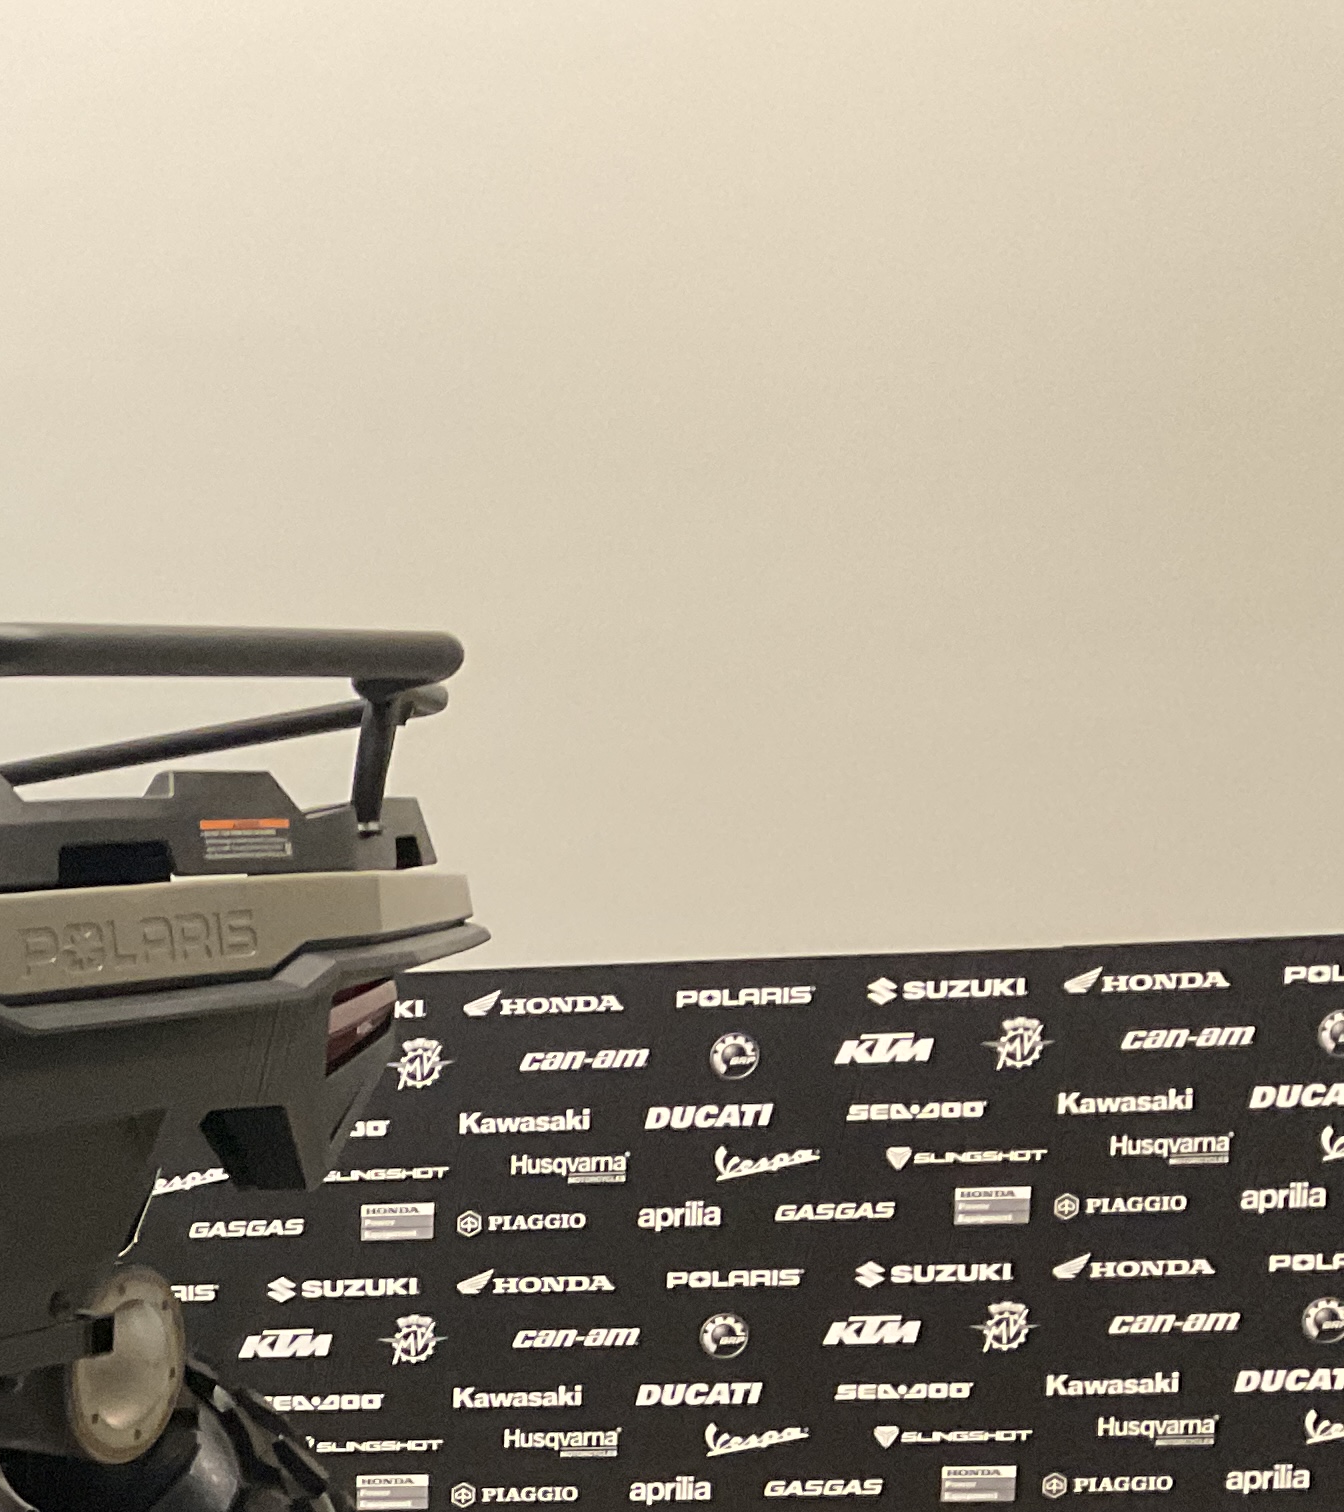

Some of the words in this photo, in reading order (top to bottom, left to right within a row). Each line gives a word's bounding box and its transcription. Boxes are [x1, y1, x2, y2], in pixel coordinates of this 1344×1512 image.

[20, 909, 258, 978] POLARIS
[902, 977, 1028, 1000] SUZUKI
[1100, 971, 1231, 993] HONDA
[500, 994, 625, 1016] HONDA
[675, 985, 817, 1009] POLARIS
[833, 1032, 935, 1065] KTM
[1120, 1025, 1256, 1050] can-am
[519, 1048, 650, 1072] can-am
[1057, 1087, 1194, 1115] Kawasaki
[1248, 1082, 1344, 1109] DUCA
[458, 1107, 591, 1135] Kawasaki
[644, 1103, 774, 1130] DUCATI
[913, 1149, 1048, 1164] SLINGSHOT
[1109, 1131, 1235, 1158] Husqvarna
[323, 1166, 450, 1184] SLINGSHOT
[510, 1151, 631, 1177] Husqvarna
[714, 1145, 821, 1182] Vespa
[151, 1167, 230, 1197] espa
[1085, 1195, 1188, 1214] PIAGGIO
[1240, 1181, 1327, 1214] aprilia
[487, 1212, 587, 1231] PIAGGIO
[637, 1200, 722, 1232] aprilia
[774, 1201, 896, 1222] GASGAS
[188, 1218, 305, 1239] GASGAS
[666, 1268, 805, 1289] POLARIS
[890, 1262, 1014, 1284] SUZUKI
[1089, 1258, 1216, 1279] HONDA
[301, 1277, 420, 1299] SUZUKI
[495, 1275, 616, 1294] HONDA
[822, 1314, 922, 1346] KTM
[1108, 1311, 1241, 1335] can-am
[237, 1328, 333, 1359] KTM
[511, 1327, 641, 1349] can-am
[1045, 1371, 1180, 1397] Kawasaki
[1233, 1367, 1344, 1393] DUCAT
[452, 1384, 583, 1409] Kawasaki
[635, 1381, 763, 1407] DUCATI
[900, 1429, 1034, 1443] SLINGSHOT
[1096, 1414, 1220, 1439] Husqvarna
[315, 1439, 444, 1453] SLINGSHOT
[503, 1427, 623, 1451] Husqvarna
[704, 1422, 810, 1458] Vespa
[629, 1475, 712, 1506] aprilia
[763, 1478, 884, 1497] GASGAS
[1072, 1475, 1174, 1493] PIAGGIO
[1225, 1463, 1311, 1495] aprilia
[481, 1486, 579, 1503] PIAGGIO
